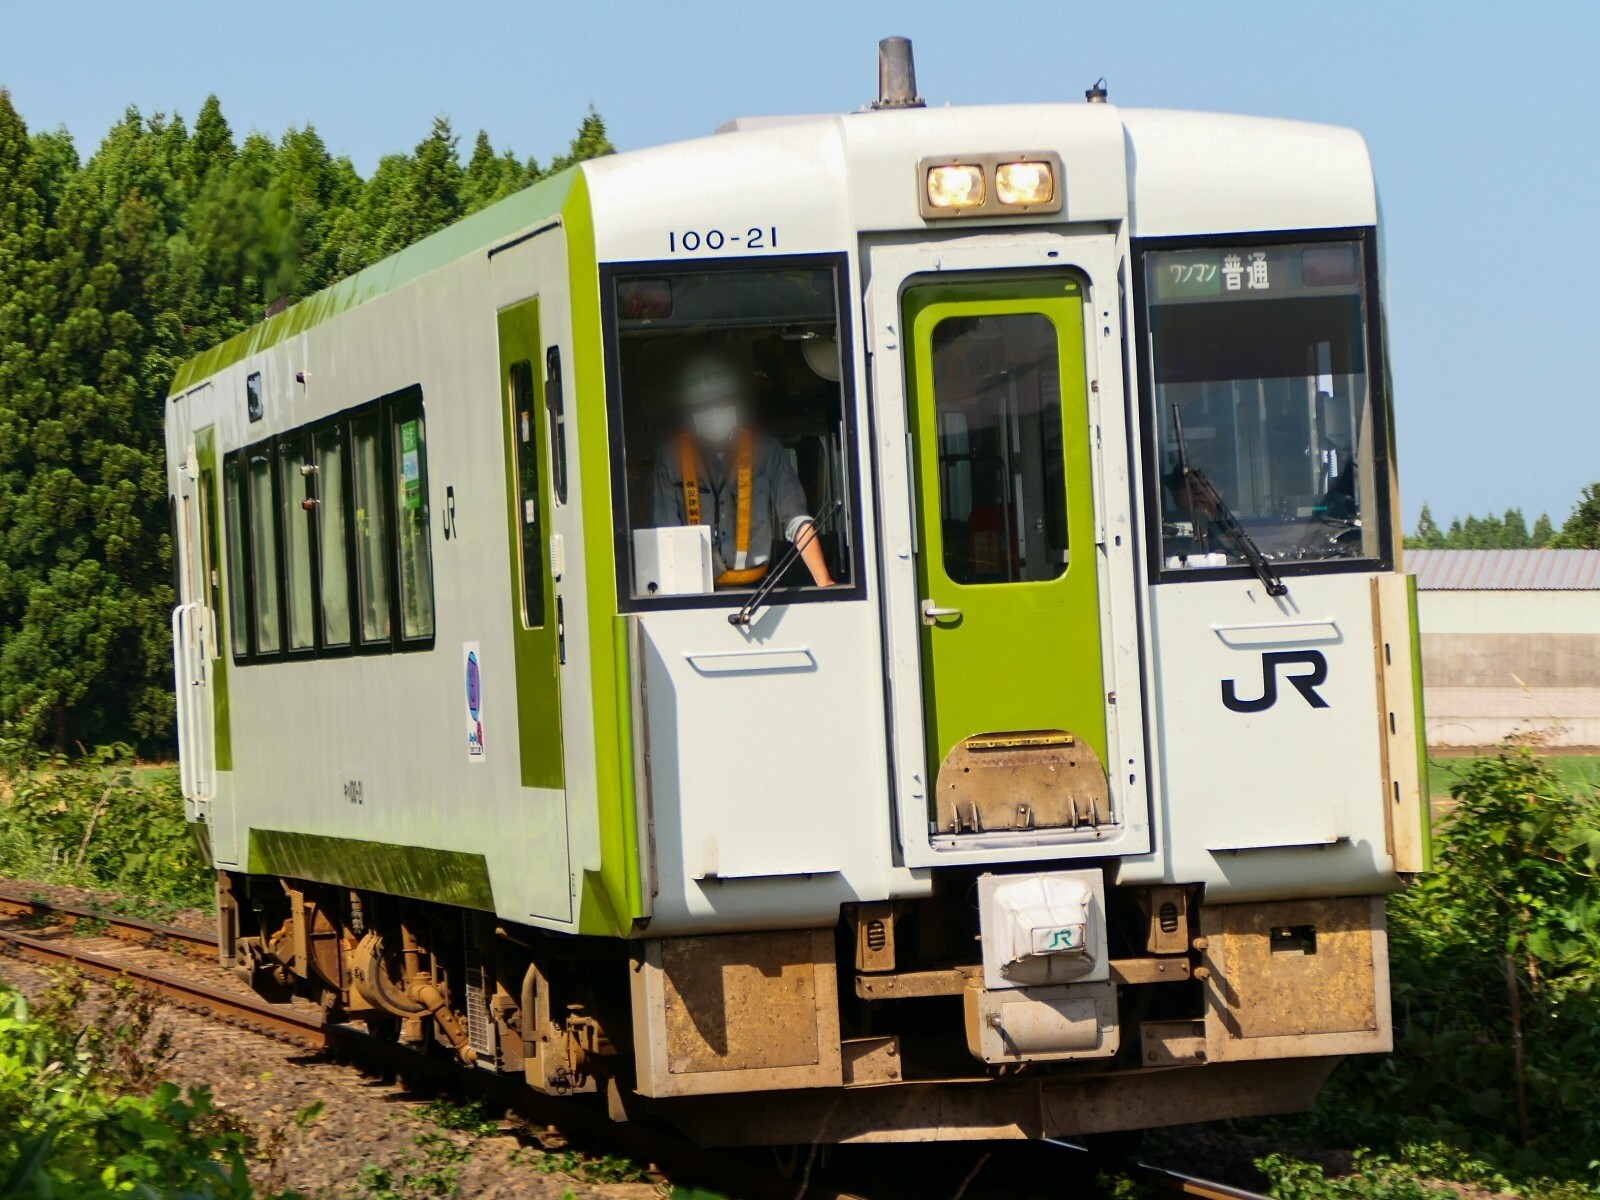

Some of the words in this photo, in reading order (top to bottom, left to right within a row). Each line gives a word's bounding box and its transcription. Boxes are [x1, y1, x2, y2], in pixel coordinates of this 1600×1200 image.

[669, 226, 777, 252] 100-21
[1170, 263, 1216, 283] ワンマン
[1222, 253, 1269, 290] 普通
[442, 486, 457, 541] JR
[1220, 649, 1331, 713] JR
[1049, 929, 1072, 948] JR
